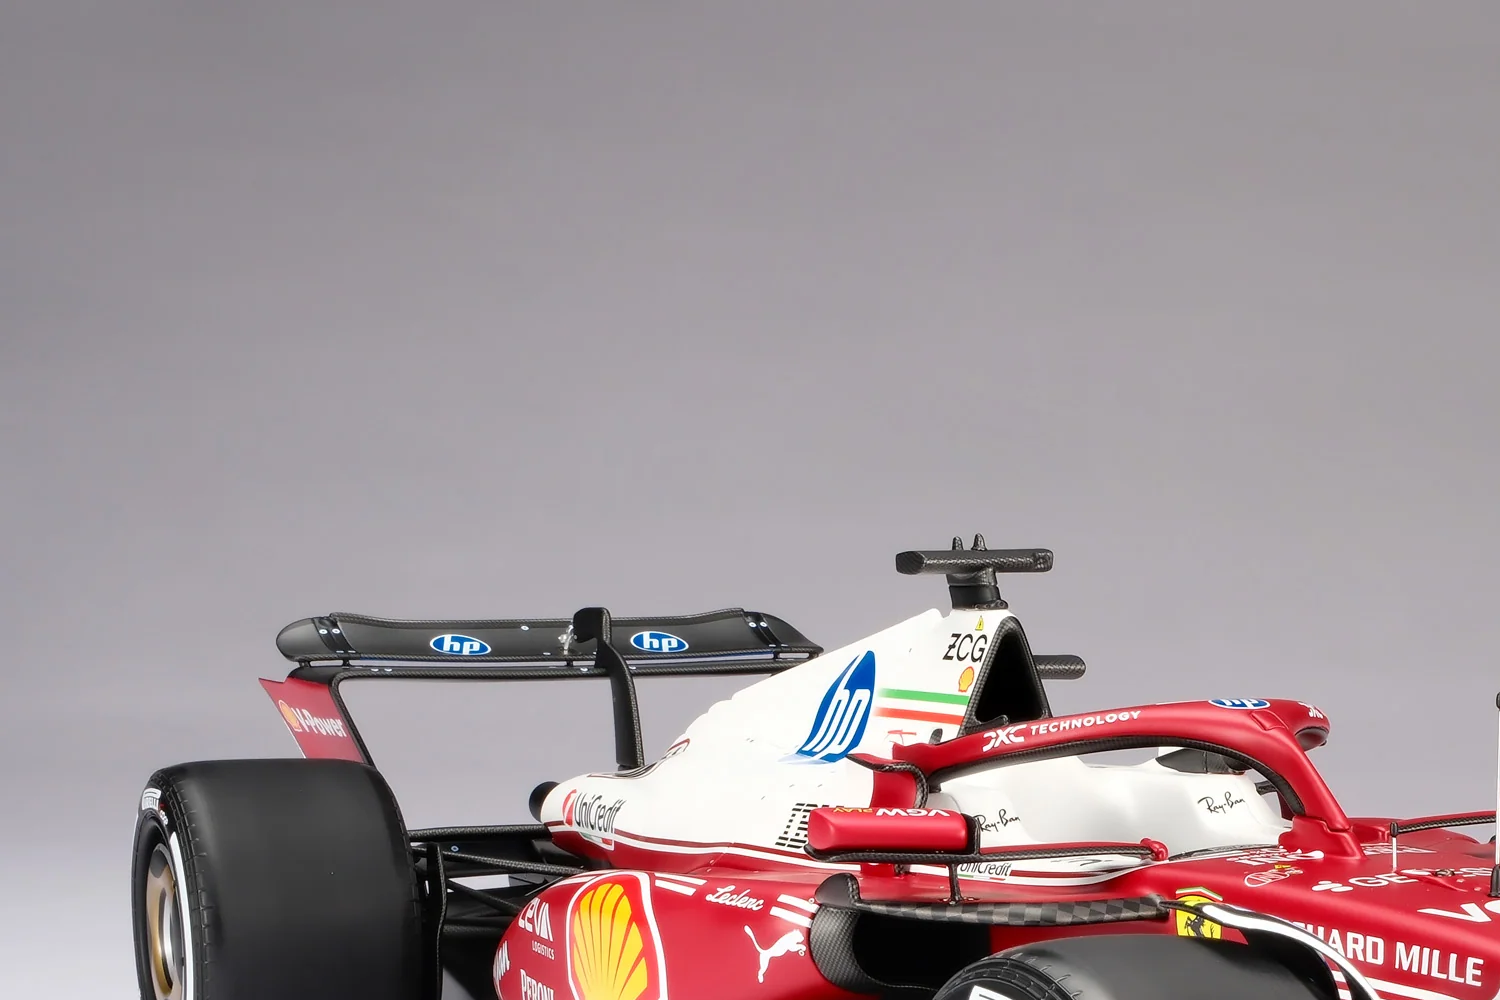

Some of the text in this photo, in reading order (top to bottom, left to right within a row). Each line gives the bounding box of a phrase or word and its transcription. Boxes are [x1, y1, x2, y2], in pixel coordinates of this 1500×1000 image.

[291, 707, 347, 738] V-Power
[1030, 710, 1142, 737] TECHNOLOGY
[574, 791, 627, 834] UniCredit
[1198, 791, 1246, 815] Ray-Ban
[775, 803, 845, 850] IB
[705, 885, 766, 912] Leclerc
[1394, 944, 1485, 988] MILLE
